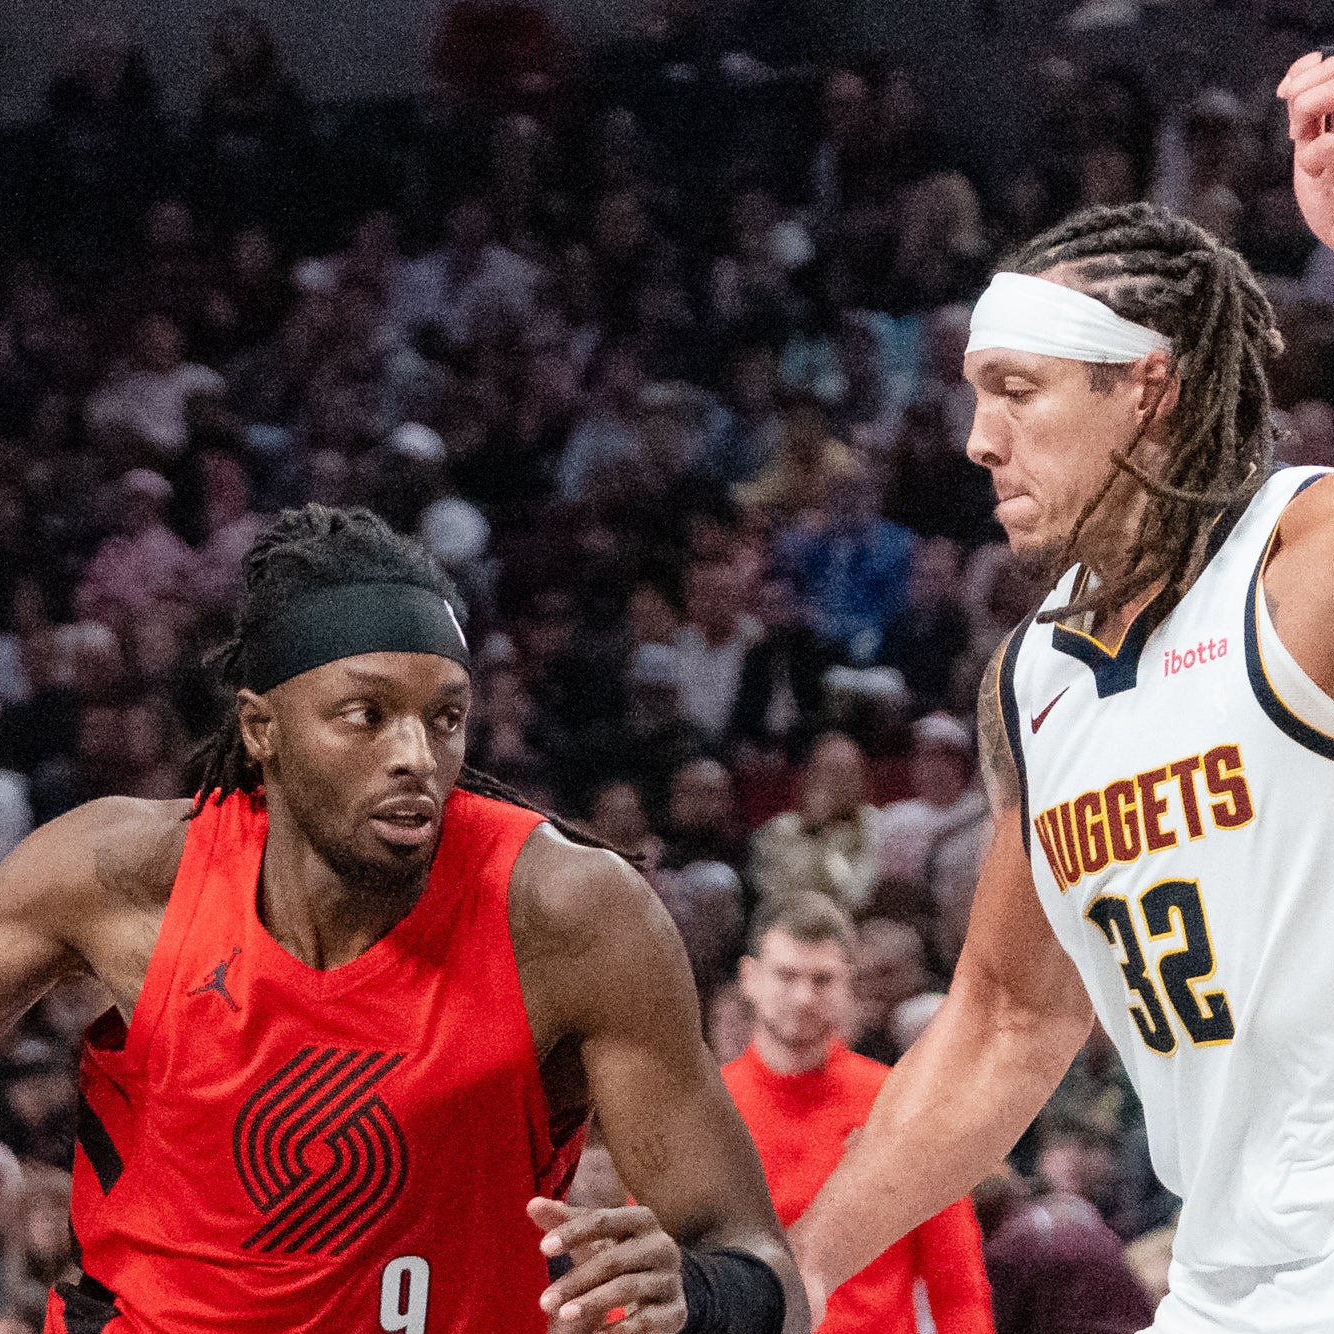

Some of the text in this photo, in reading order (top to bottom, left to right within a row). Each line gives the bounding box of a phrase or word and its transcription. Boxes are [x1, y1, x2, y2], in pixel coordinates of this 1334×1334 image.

[1163, 635, 1228, 677] ibotta
[1033, 743, 1255, 894] NUGGETS
[1083, 876, 1236, 1057] 32
